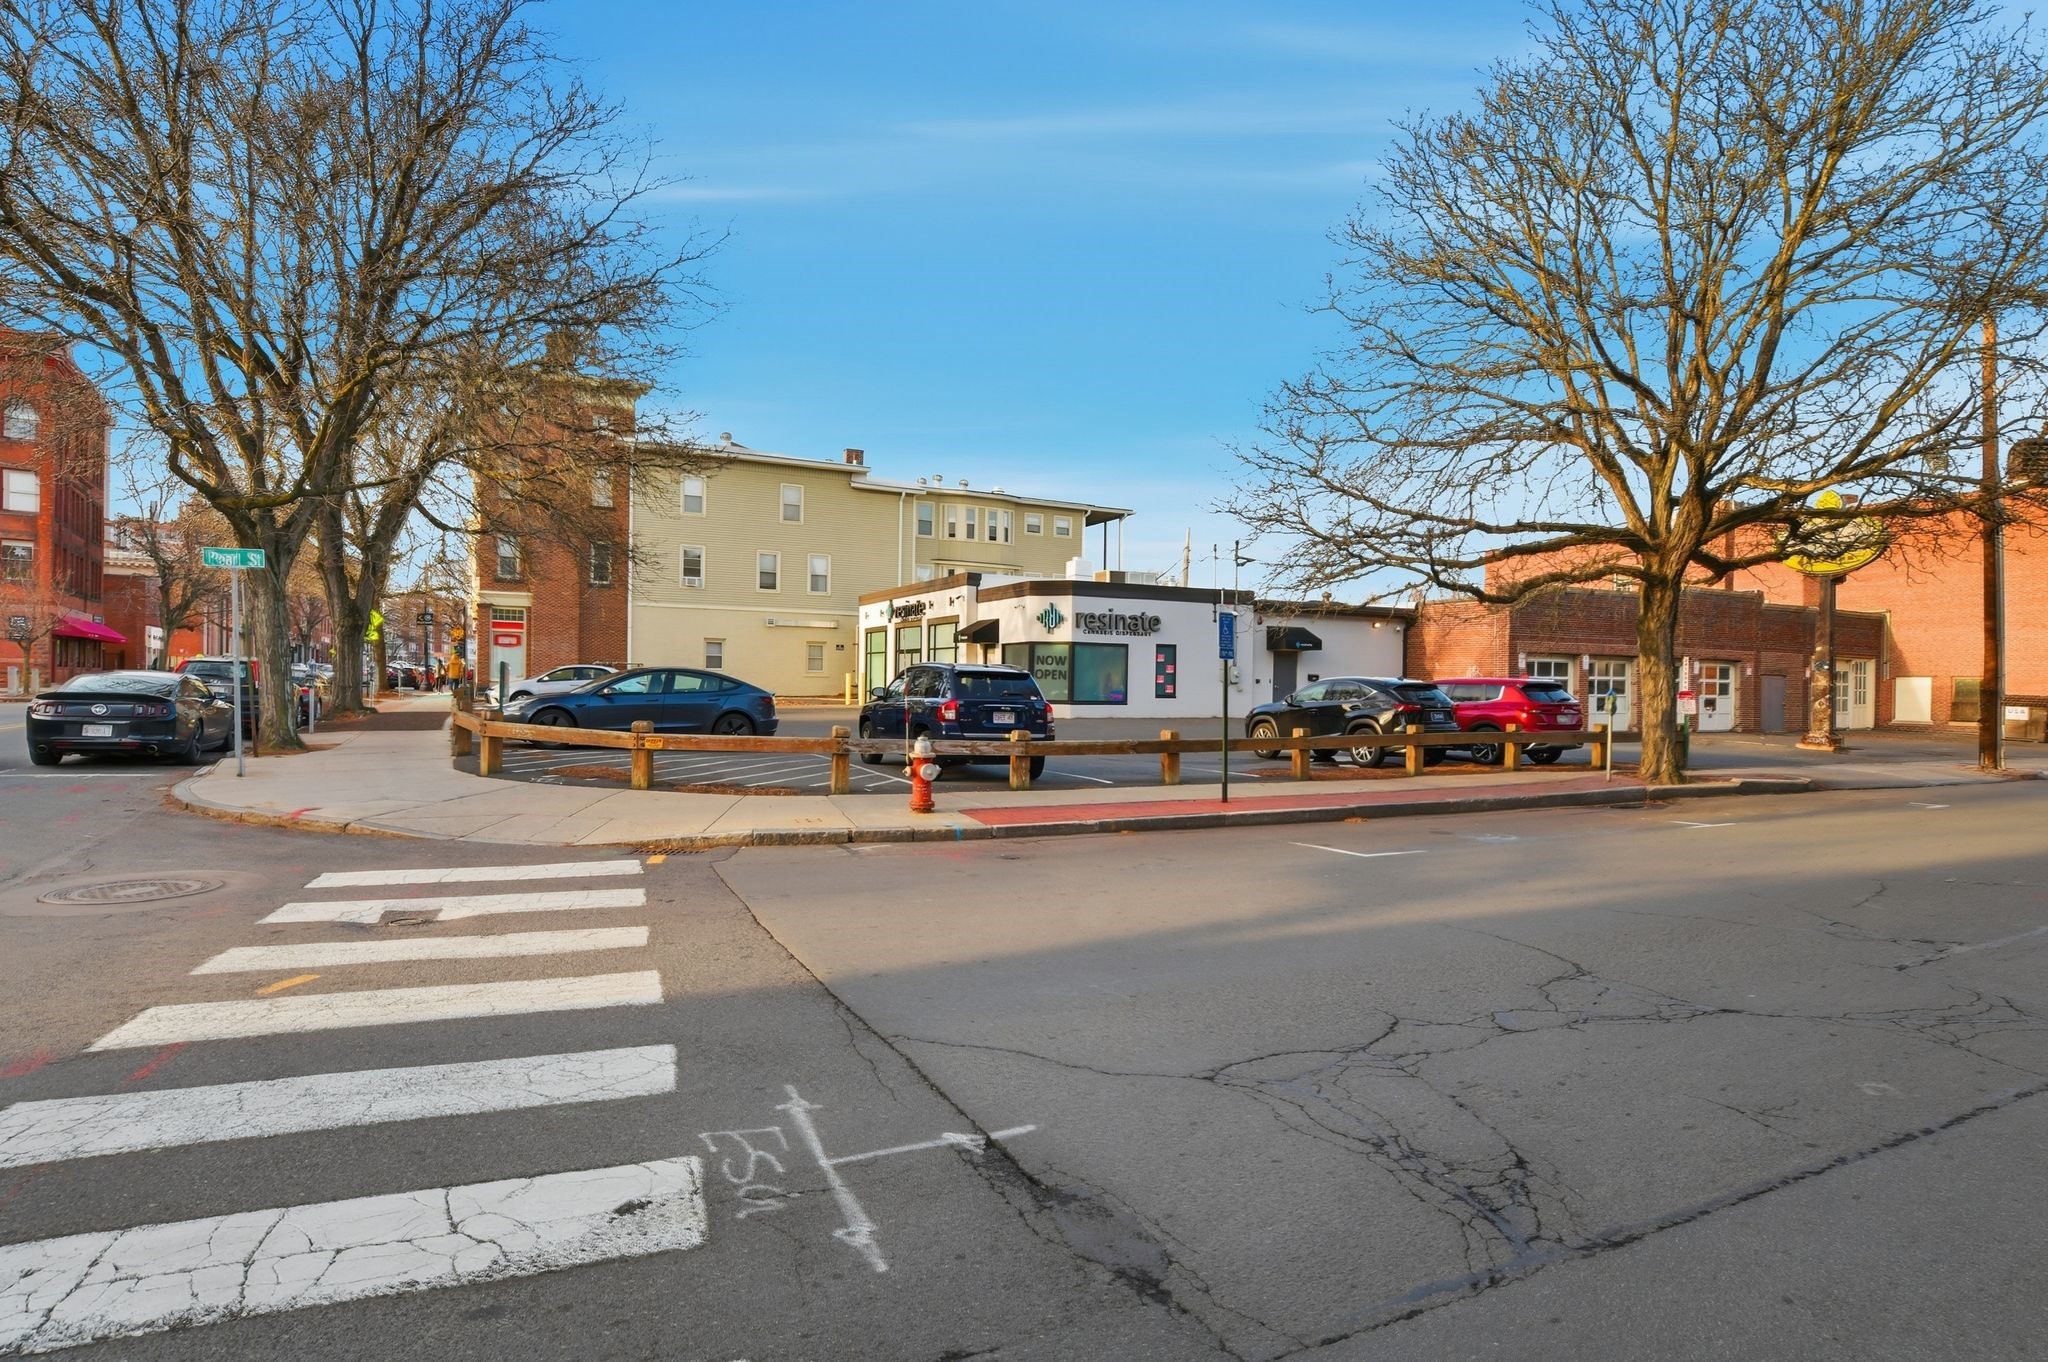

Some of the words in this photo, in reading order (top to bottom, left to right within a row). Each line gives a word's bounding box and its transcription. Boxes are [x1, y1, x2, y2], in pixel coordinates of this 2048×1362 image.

[1075, 608, 1162, 633] resinate
[1036, 655, 1067, 666] NOW
[1035, 668, 1067, 680] OPEN
